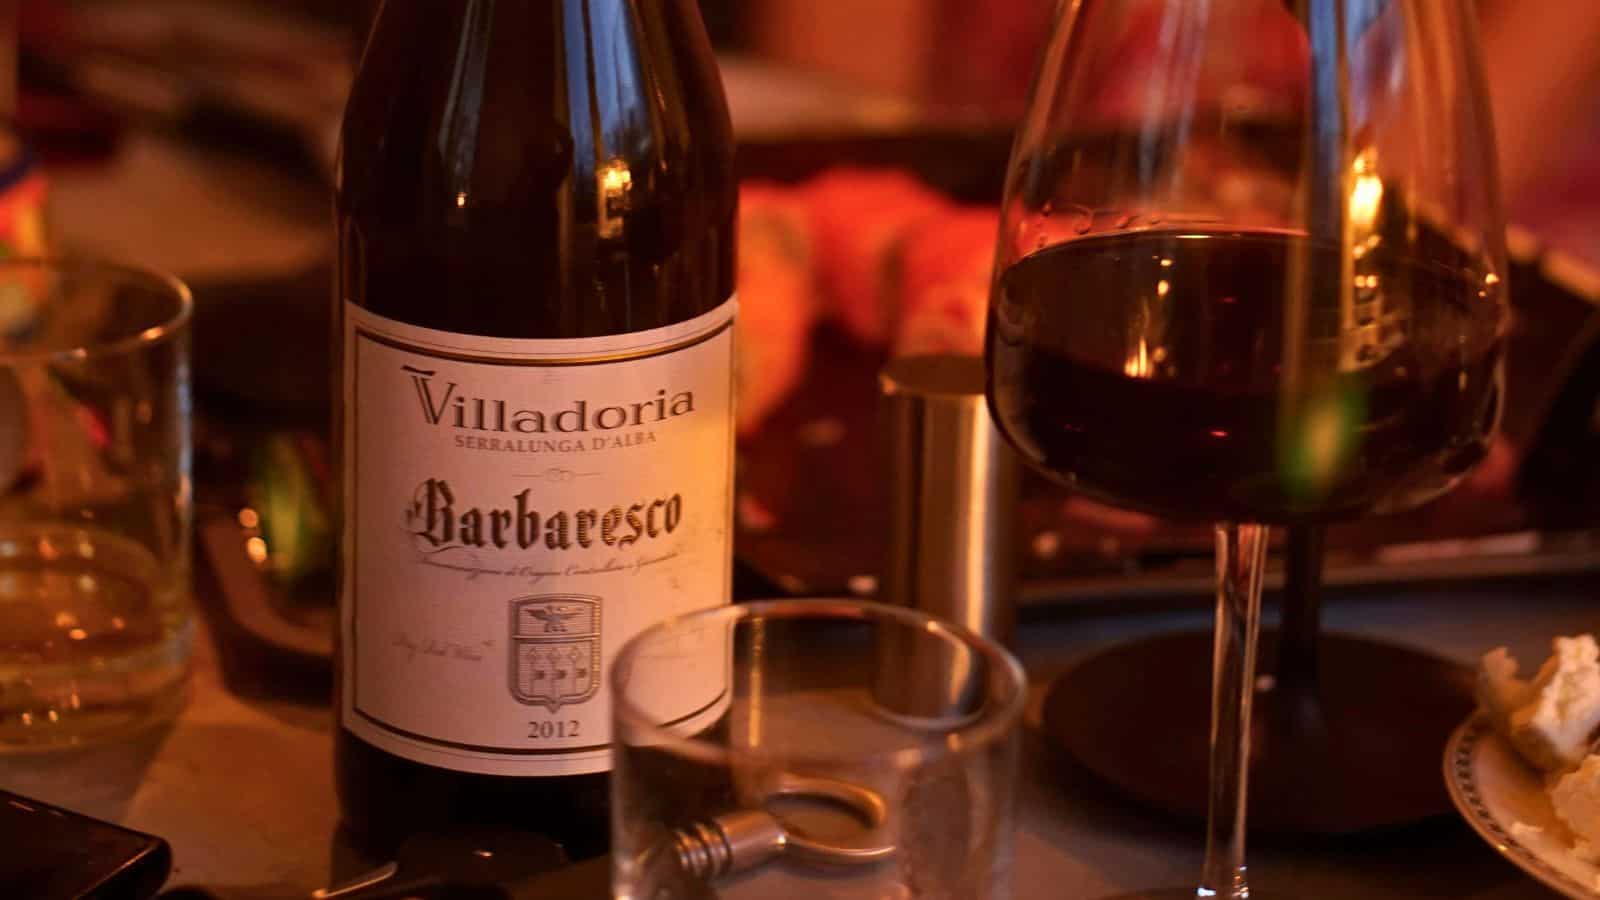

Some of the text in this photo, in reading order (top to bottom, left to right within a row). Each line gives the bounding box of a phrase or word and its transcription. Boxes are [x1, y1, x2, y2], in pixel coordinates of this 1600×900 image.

[401, 365, 696, 434] Villadoria
[454, 431, 657, 452] SERRALUNGA D'ALBA
[404, 477, 683, 551] Barbaresco
[526, 719, 580, 739] 2012
